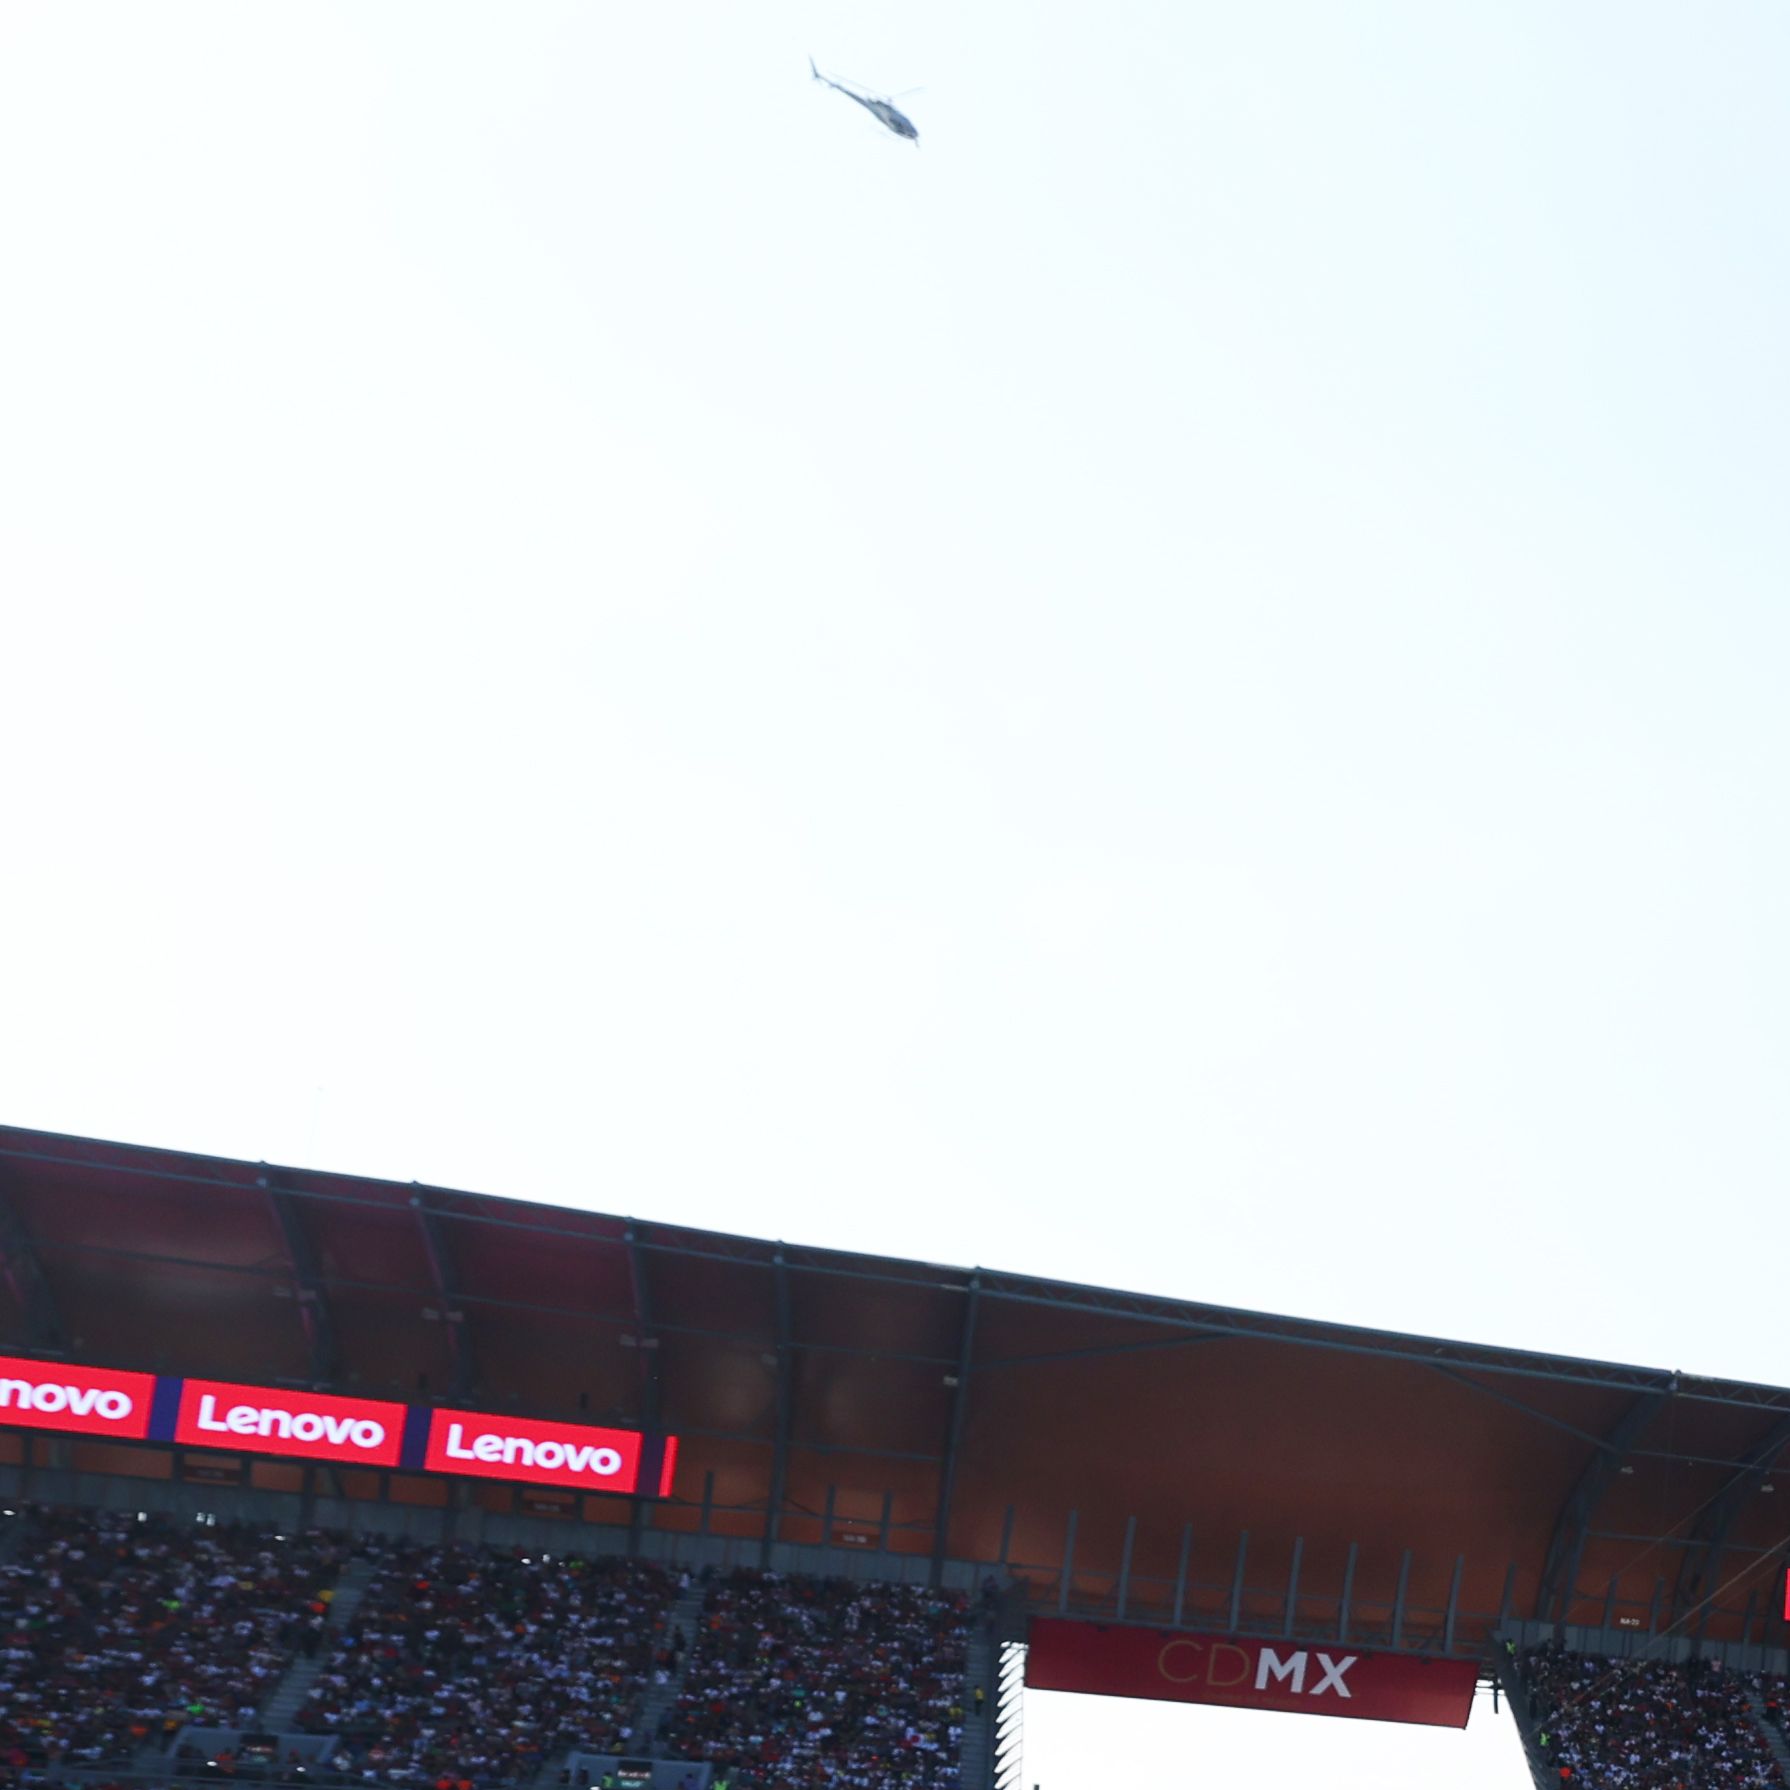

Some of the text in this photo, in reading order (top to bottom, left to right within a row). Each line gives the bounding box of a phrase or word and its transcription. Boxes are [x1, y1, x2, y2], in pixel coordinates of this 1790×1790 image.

[0, 1378, 132, 1420] novo
[197, 1394, 385, 1448] Lenovo
[446, 1423, 622, 1475] Lenovo
[1158, 1640, 1358, 1698] CDMX
